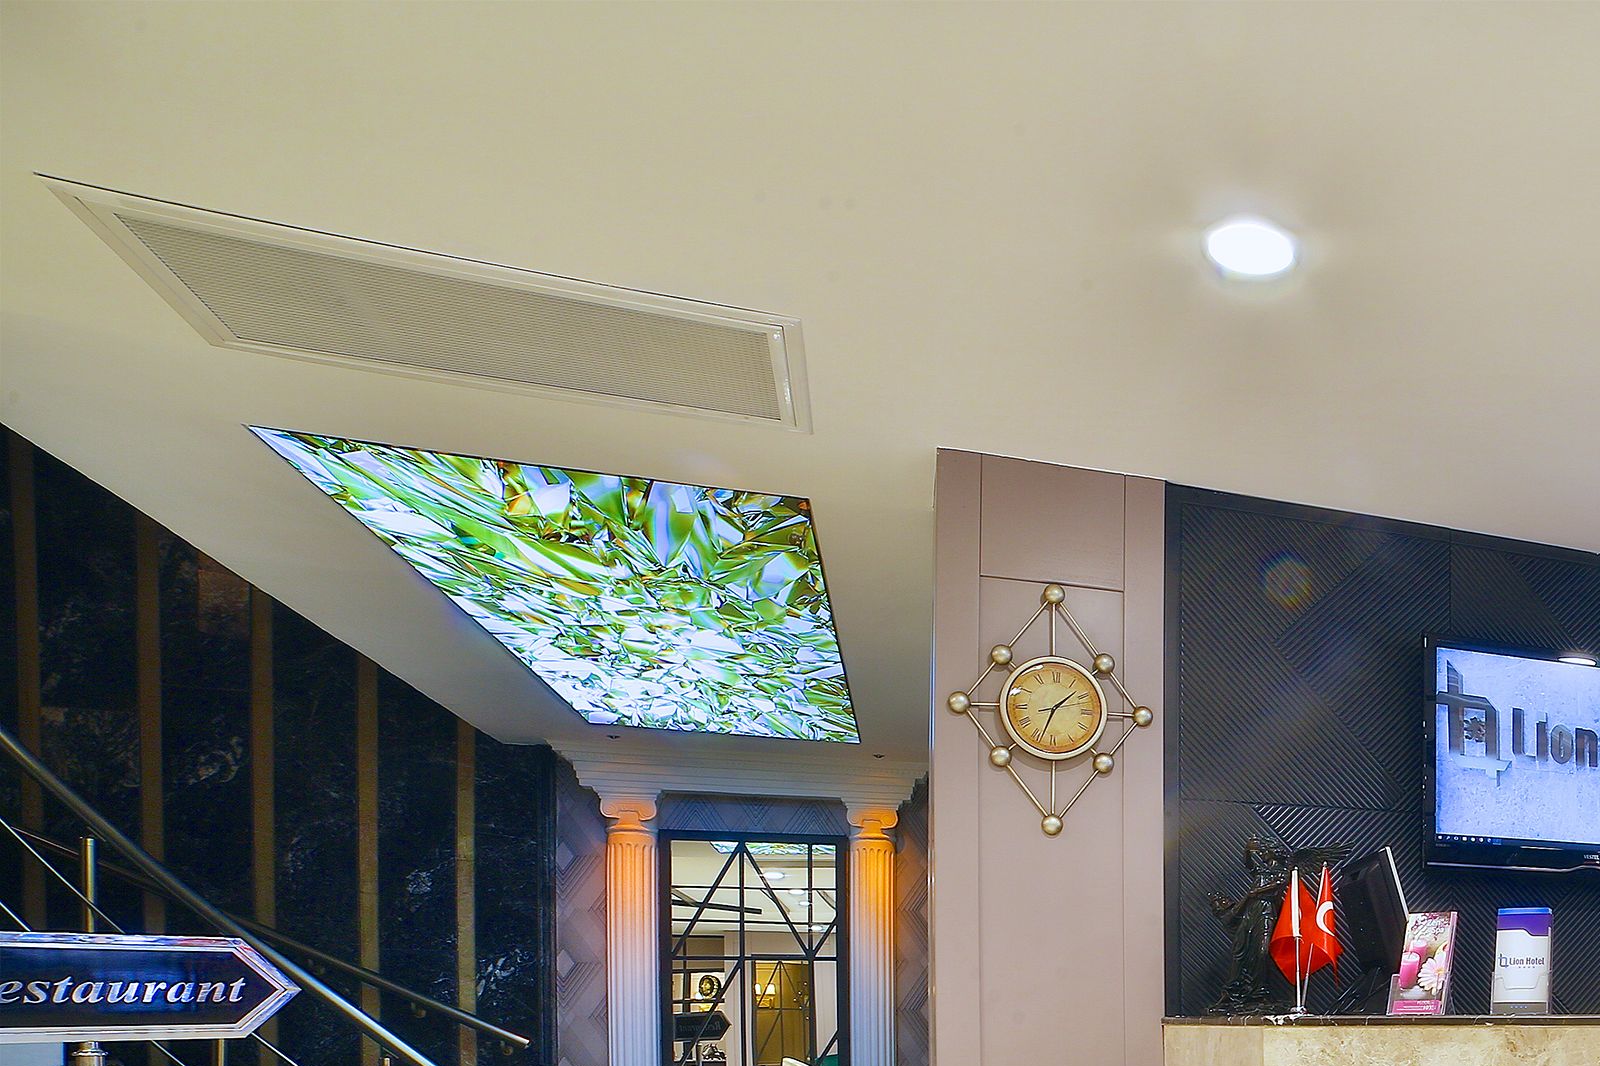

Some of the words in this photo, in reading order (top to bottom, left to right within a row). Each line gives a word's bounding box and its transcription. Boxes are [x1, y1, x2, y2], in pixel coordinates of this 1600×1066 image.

[1511, 707, 1599, 769] Lion
[1509, 957, 1524, 965] Lion
[1526, 957, 1544, 965] Hotel
